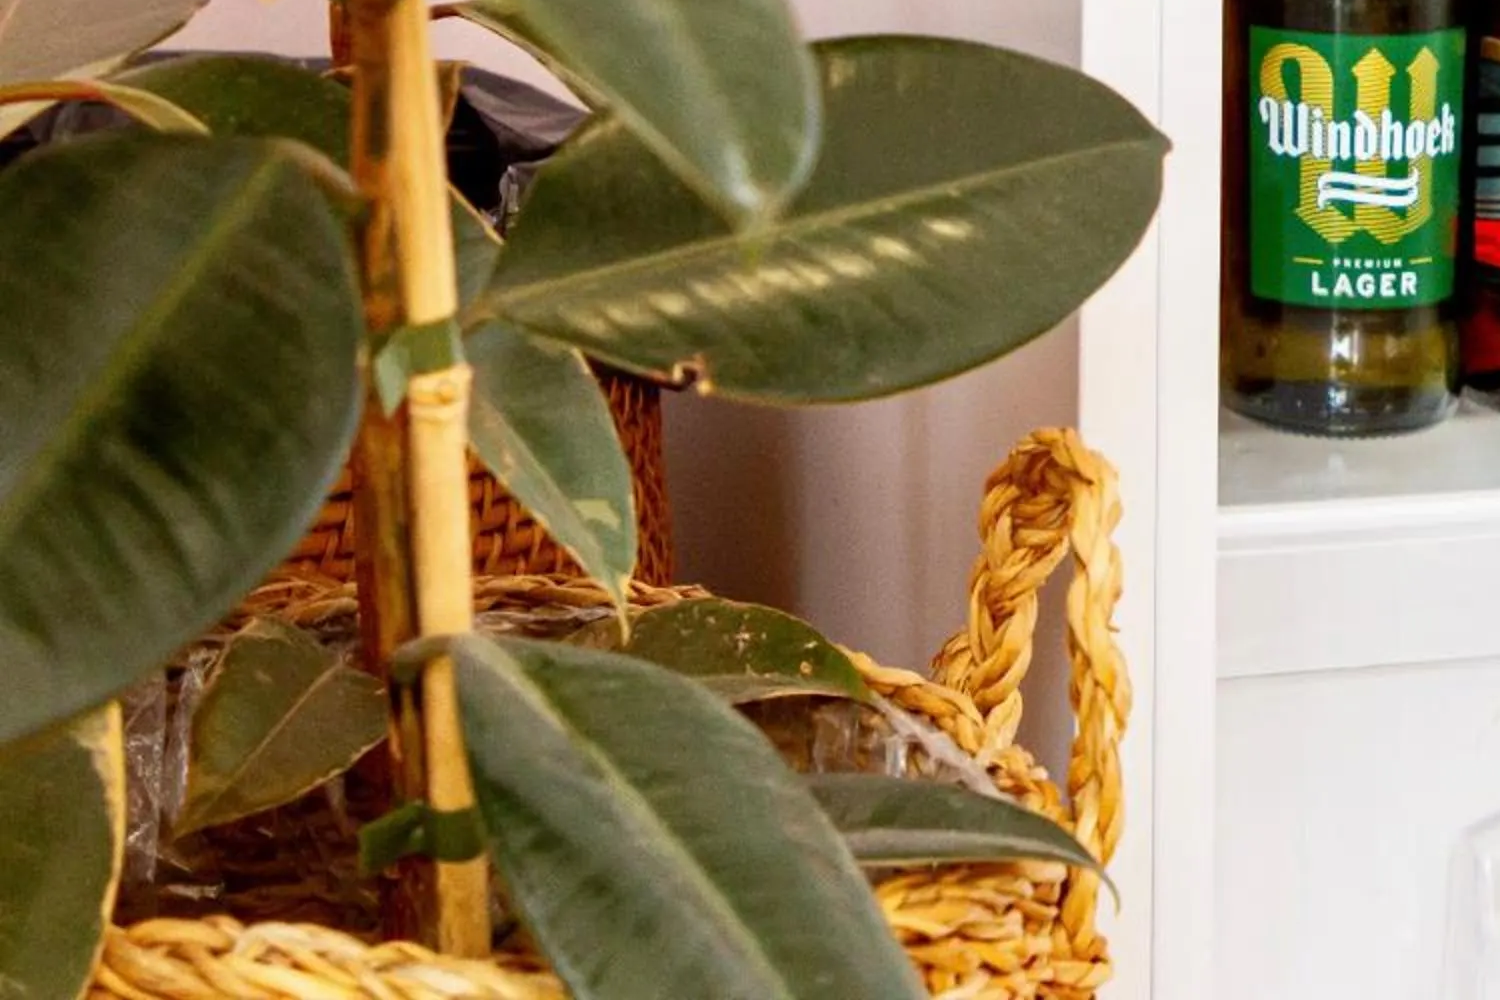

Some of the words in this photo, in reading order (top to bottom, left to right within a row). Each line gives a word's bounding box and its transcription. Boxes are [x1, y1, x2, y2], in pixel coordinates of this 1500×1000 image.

[1258, 95, 1455, 161] Windhoek
[1332, 257, 1403, 269] PREMIUM
[1311, 270, 1418, 299] LAGER
